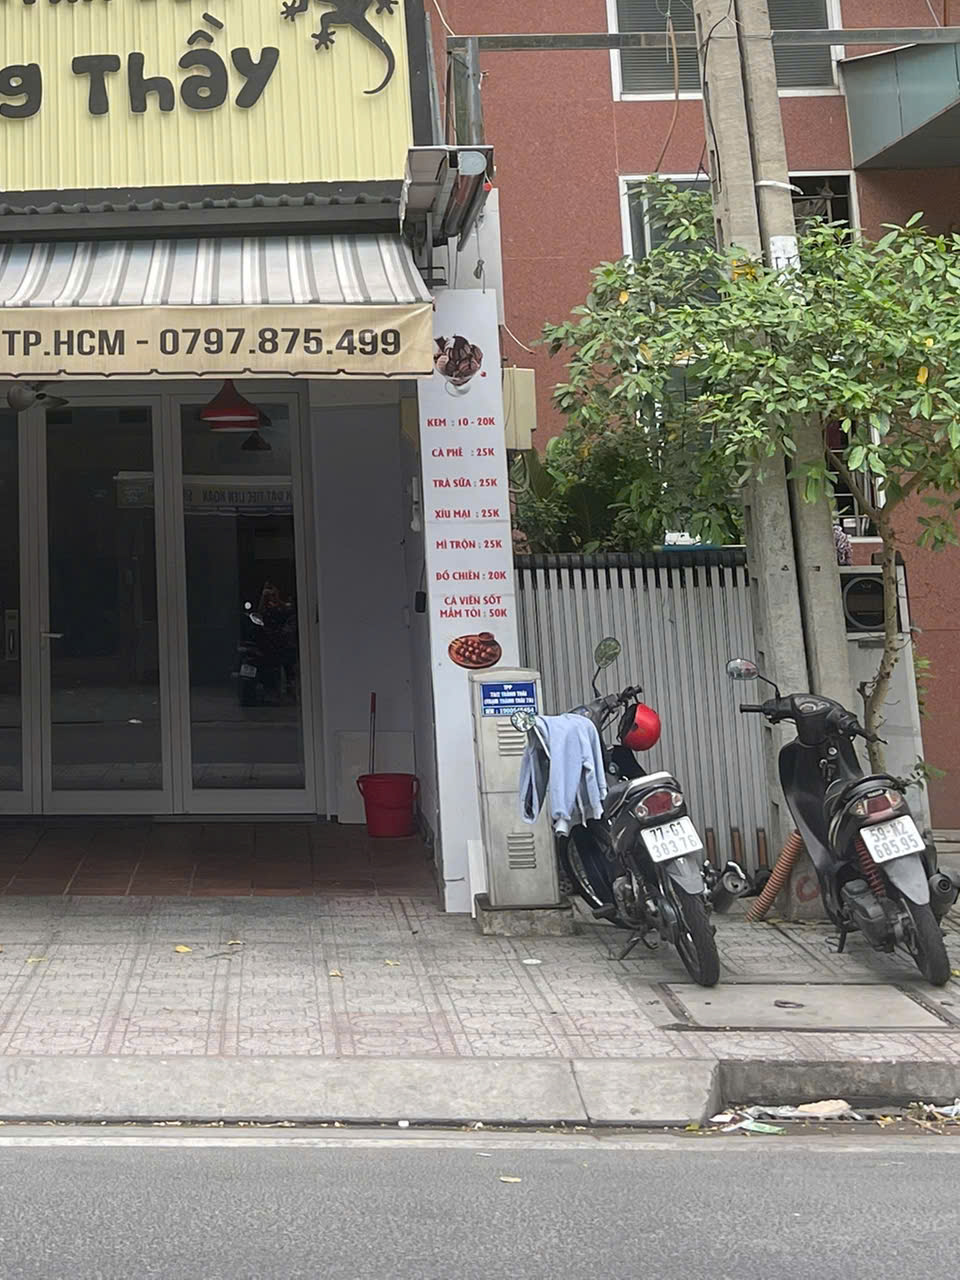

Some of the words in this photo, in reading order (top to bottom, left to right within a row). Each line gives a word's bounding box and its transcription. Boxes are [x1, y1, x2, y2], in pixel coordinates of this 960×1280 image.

[71, 12, 281, 116] Thầy
[2, 327, 126, 357] TP.HCM
[159, 326, 402, 357] 0797.875.499
[427, 418, 447, 427] KEM
[458, 417, 469, 426] 10
[477, 416, 496, 426] 20K
[446, 445, 464, 457] PHÊ
[476, 447, 495, 457] 25K
[432, 477, 451, 488] TRÀ
[453, 476, 472, 488] SỮA
[479, 478, 498, 487] 25K
[481, 508, 500, 518] 25K
[449, 538, 476, 550] TRỘN
[483, 539, 502, 549] 25K
[452, 570, 480, 581] CHIÊN
[488, 570, 507, 580] 20K
[459, 595, 480, 605] VIÊN
[489, 608, 507, 618] 50K
